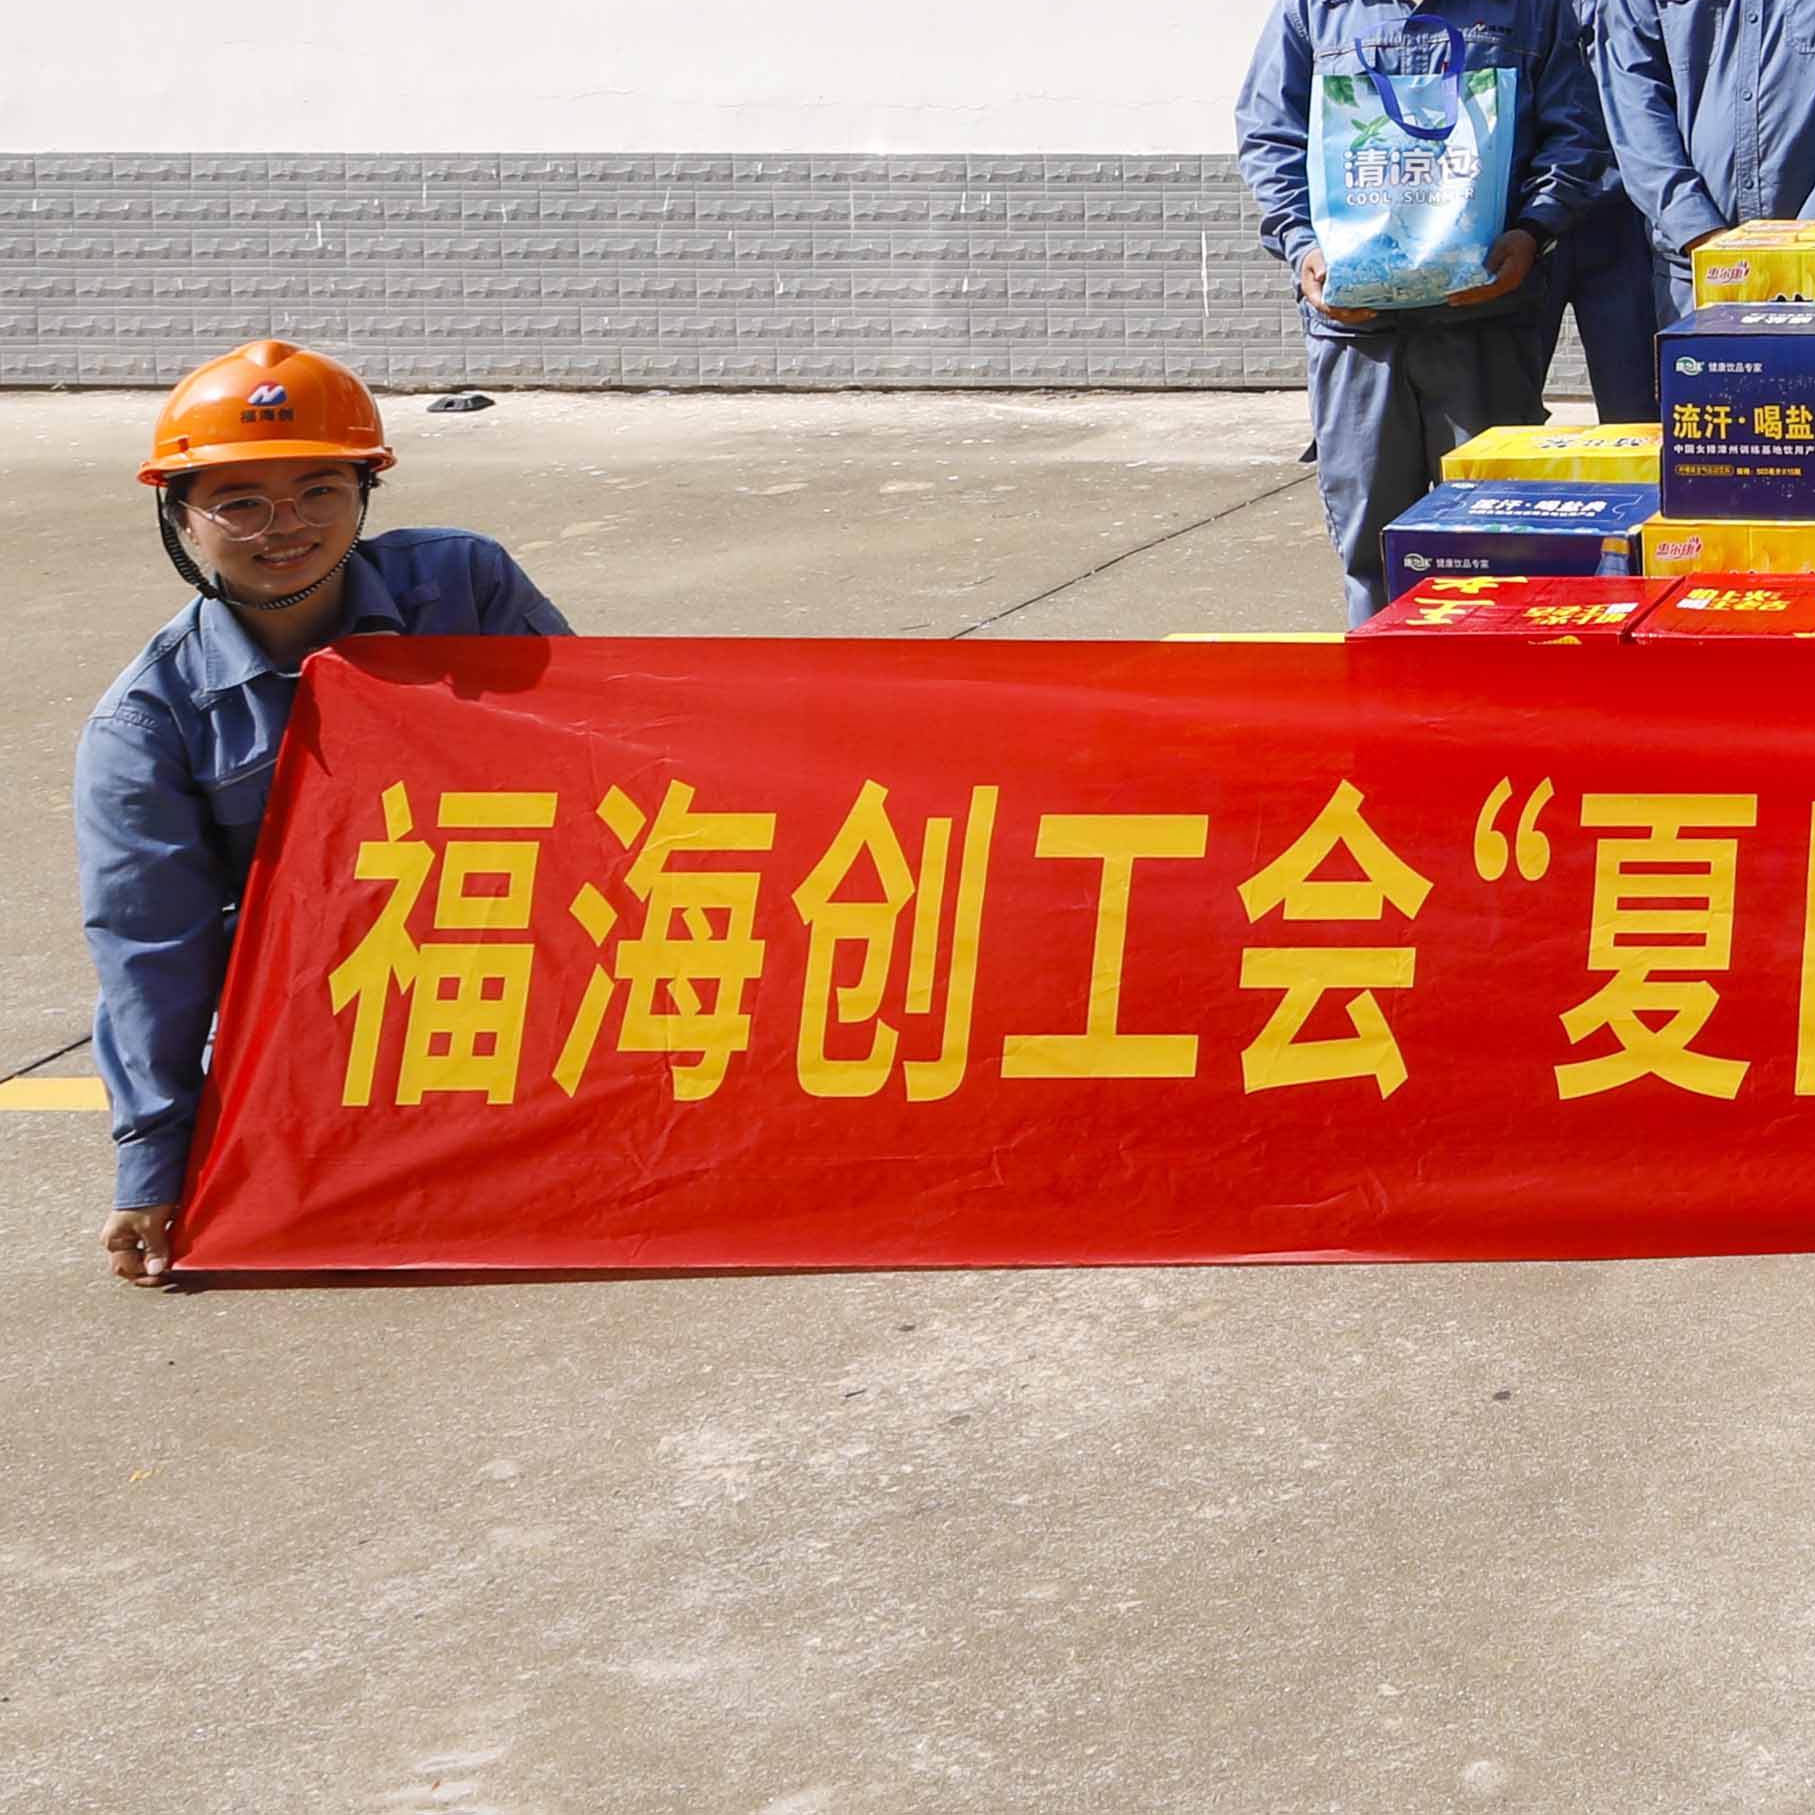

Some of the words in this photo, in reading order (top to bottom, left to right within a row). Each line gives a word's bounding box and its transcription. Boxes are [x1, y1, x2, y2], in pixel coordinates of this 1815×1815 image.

[1343, 147, 1482, 188] 清凉包
[1346, 193, 1391, 207] COOL
[1708, 361, 1764, 373] 健康饮品专家
[1436, 557, 1490, 570] 健康饮品专家
